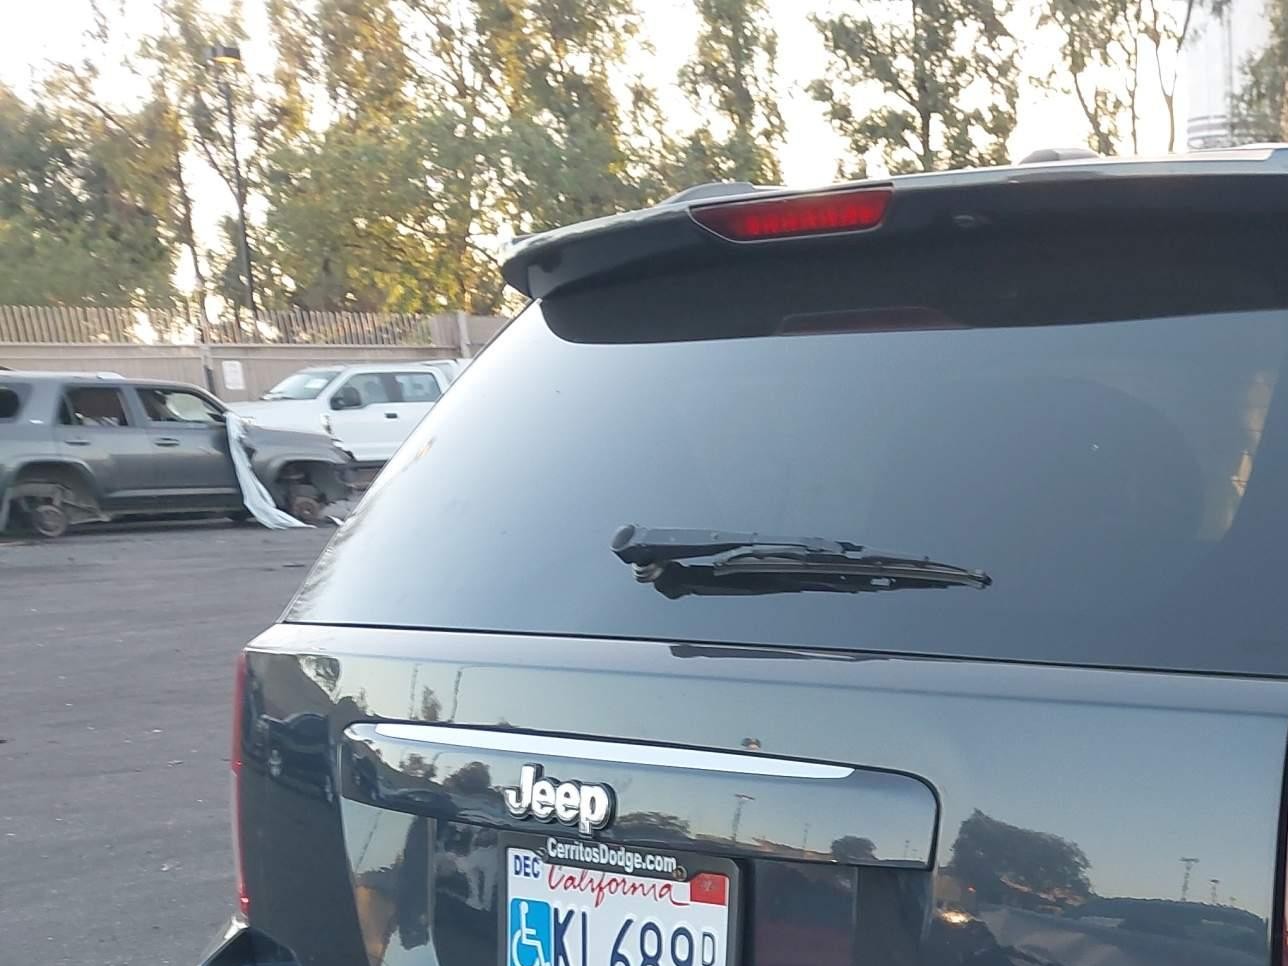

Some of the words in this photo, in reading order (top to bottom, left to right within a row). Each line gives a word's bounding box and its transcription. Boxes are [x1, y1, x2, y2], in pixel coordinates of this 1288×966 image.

[504, 763, 616, 837] Jeep
[513, 854, 541, 879] DEC
[547, 837, 677, 873] CerritosDodge.com
[548, 863, 690, 907] California
